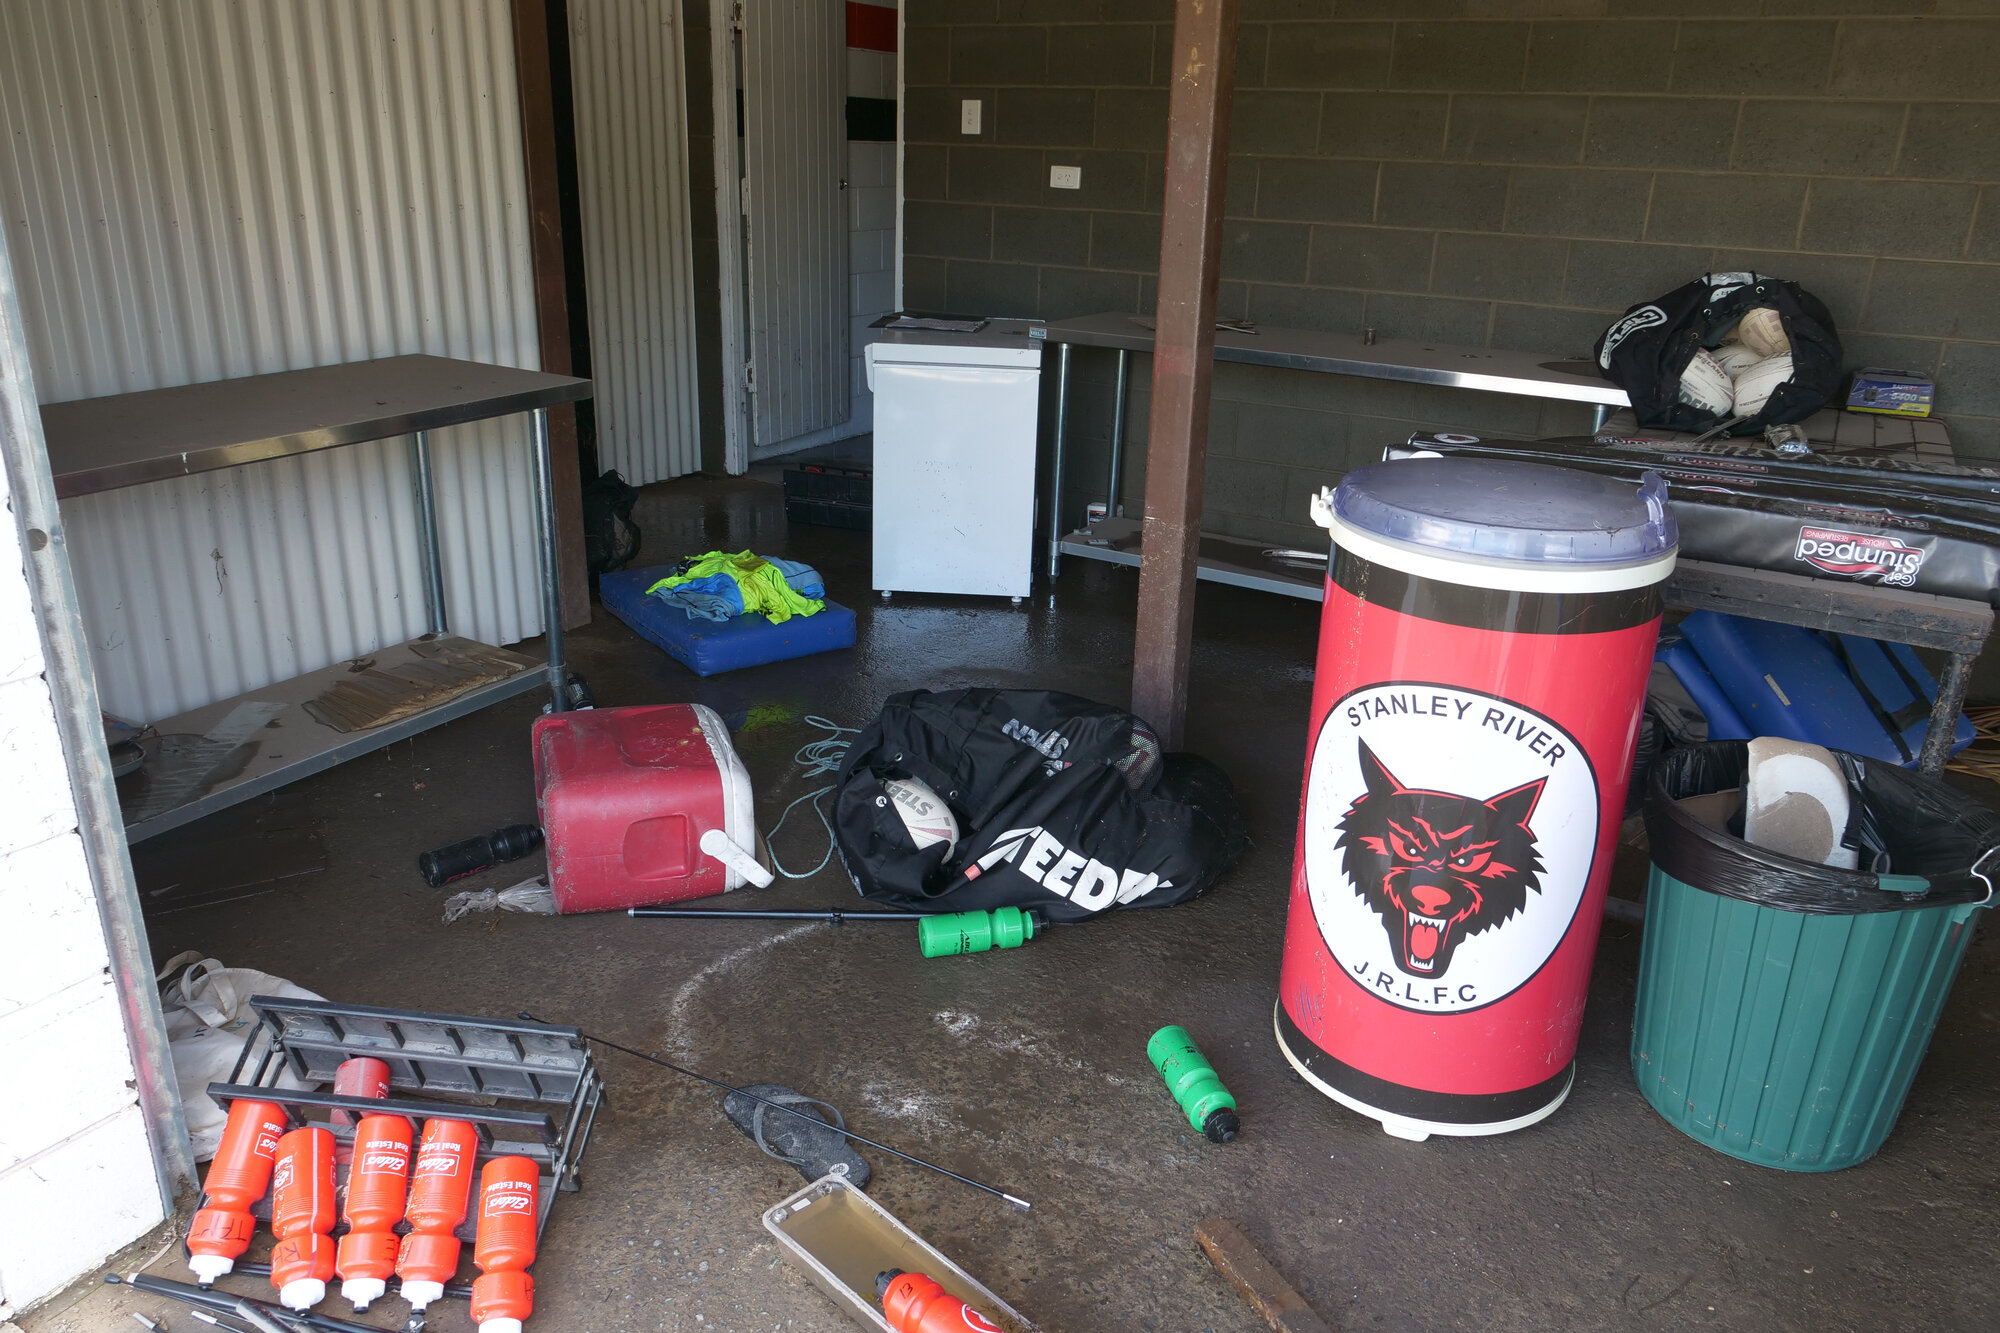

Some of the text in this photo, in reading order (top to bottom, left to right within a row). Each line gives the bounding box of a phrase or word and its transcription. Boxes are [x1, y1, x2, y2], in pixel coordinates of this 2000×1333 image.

[1805, 530, 1886, 548] HOUSE RESTUMPING
[1797, 538, 1919, 574] Stumped
[1888, 571, 1913, 585] Get
[1346, 693, 1567, 767] STANLEY RIVER
[1353, 959, 1479, 1006] J.R.L.F.C
[366, 1140, 409, 1153] Real Estate
[442, 1141, 461, 1153] Real
[365, 1156, 406, 1172] Elders
[418, 1156, 456, 1172] Elders
[487, 1180, 533, 1192] Real Estate
[488, 1195, 530, 1210] Elders
[898, 1282, 914, 1299] 13
